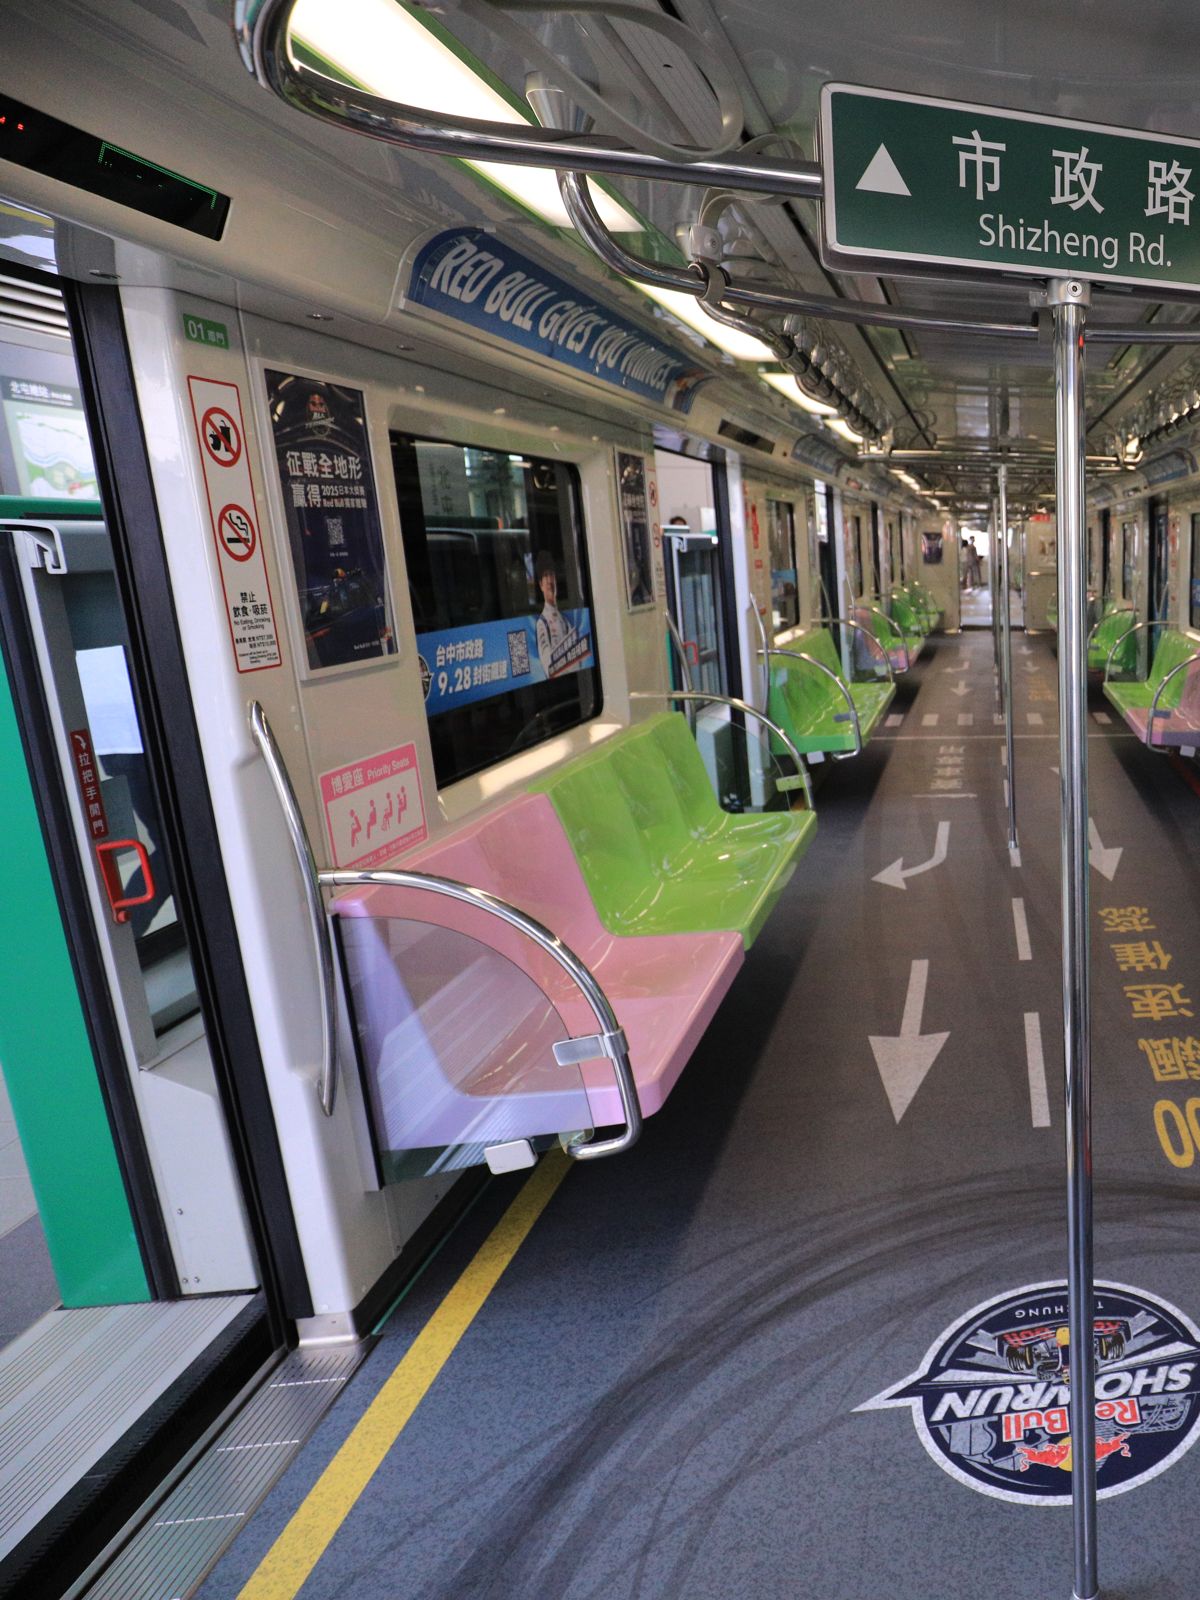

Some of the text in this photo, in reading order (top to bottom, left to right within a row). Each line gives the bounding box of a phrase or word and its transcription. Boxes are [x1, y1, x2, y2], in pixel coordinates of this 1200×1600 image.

[951, 129, 1195, 227] 市政路
[978, 213, 1174, 268] Shizheng Rd.
[429, 241, 505, 303] RED
[483, 271, 559, 332] BULL
[538, 299, 601, 356] GIVES
[588, 322, 640, 370] YOU
[188, 320, 205, 340] 01
[286, 450, 363, 480] 征戰全地形
[290, 483, 322, 508] 贏得
[240, 591, 257, 604] 禁止
[435, 637, 485, 668] 台中市政路
[438, 664, 473, 697] 9.28
[367, 764, 392, 781] Priority
[77, 751, 106, 835] 拉把手開門
[1002, 1407, 1070, 1443] Bull
